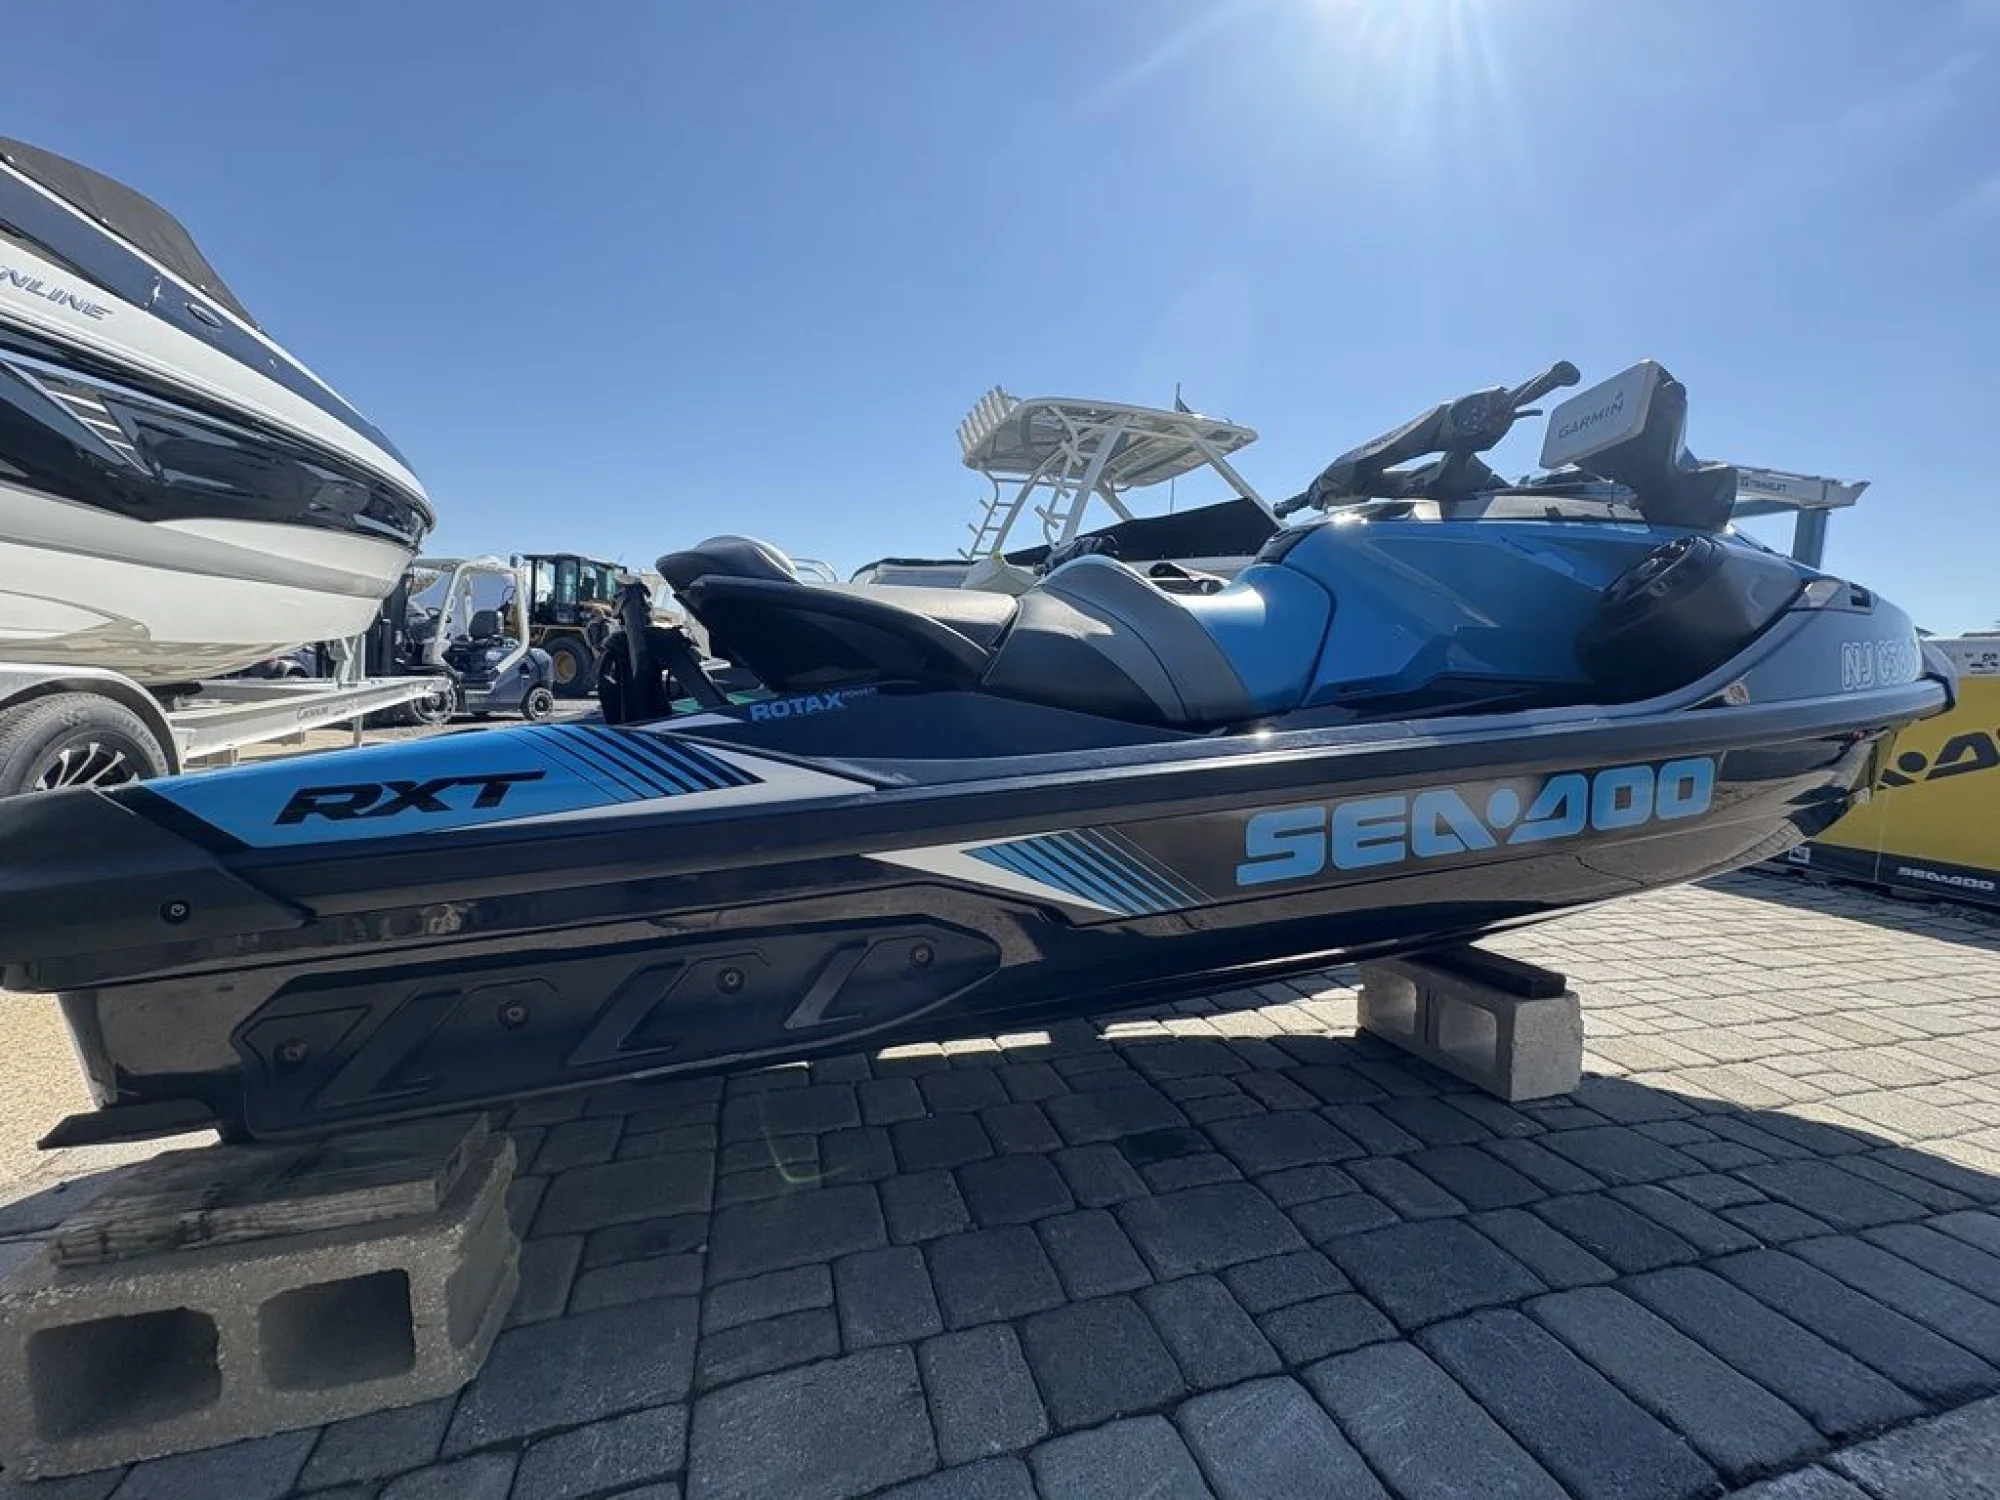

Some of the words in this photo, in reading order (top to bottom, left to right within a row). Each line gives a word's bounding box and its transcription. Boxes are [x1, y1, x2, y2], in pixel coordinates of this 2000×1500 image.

[1559, 400, 1623, 438] GARMIN
[751, 692, 846, 721] ROTAX
[274, 770, 547, 825] RXT
